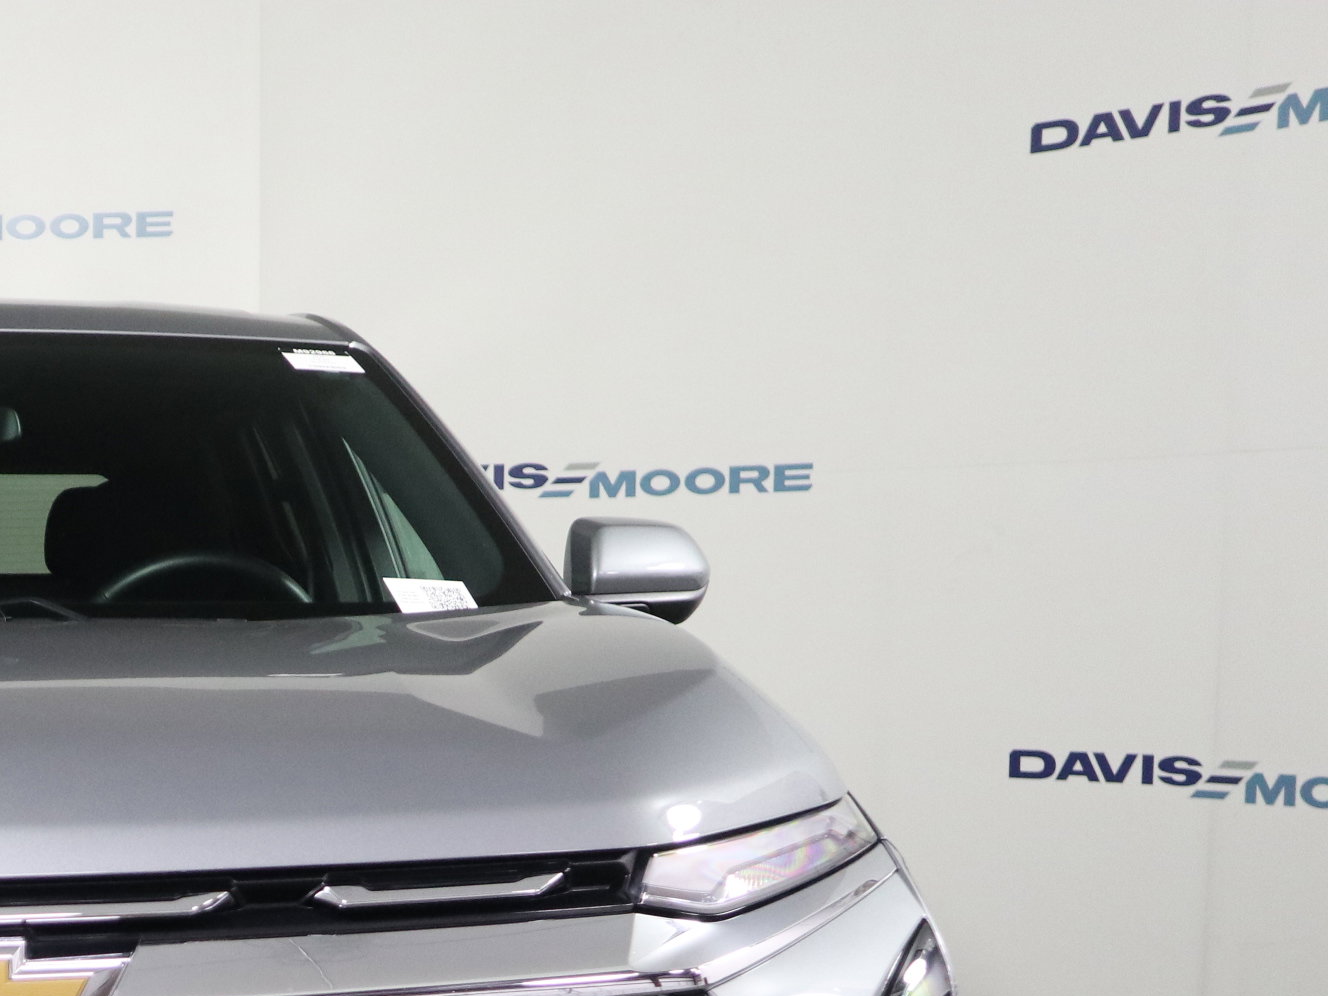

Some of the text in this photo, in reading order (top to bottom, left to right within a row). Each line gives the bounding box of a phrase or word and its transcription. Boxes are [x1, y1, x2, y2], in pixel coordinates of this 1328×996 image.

[1030, 94, 1232, 154] DAVIS
[588, 462, 814, 499] MOORE
[1008, 749, 1203, 786] DAVIS
